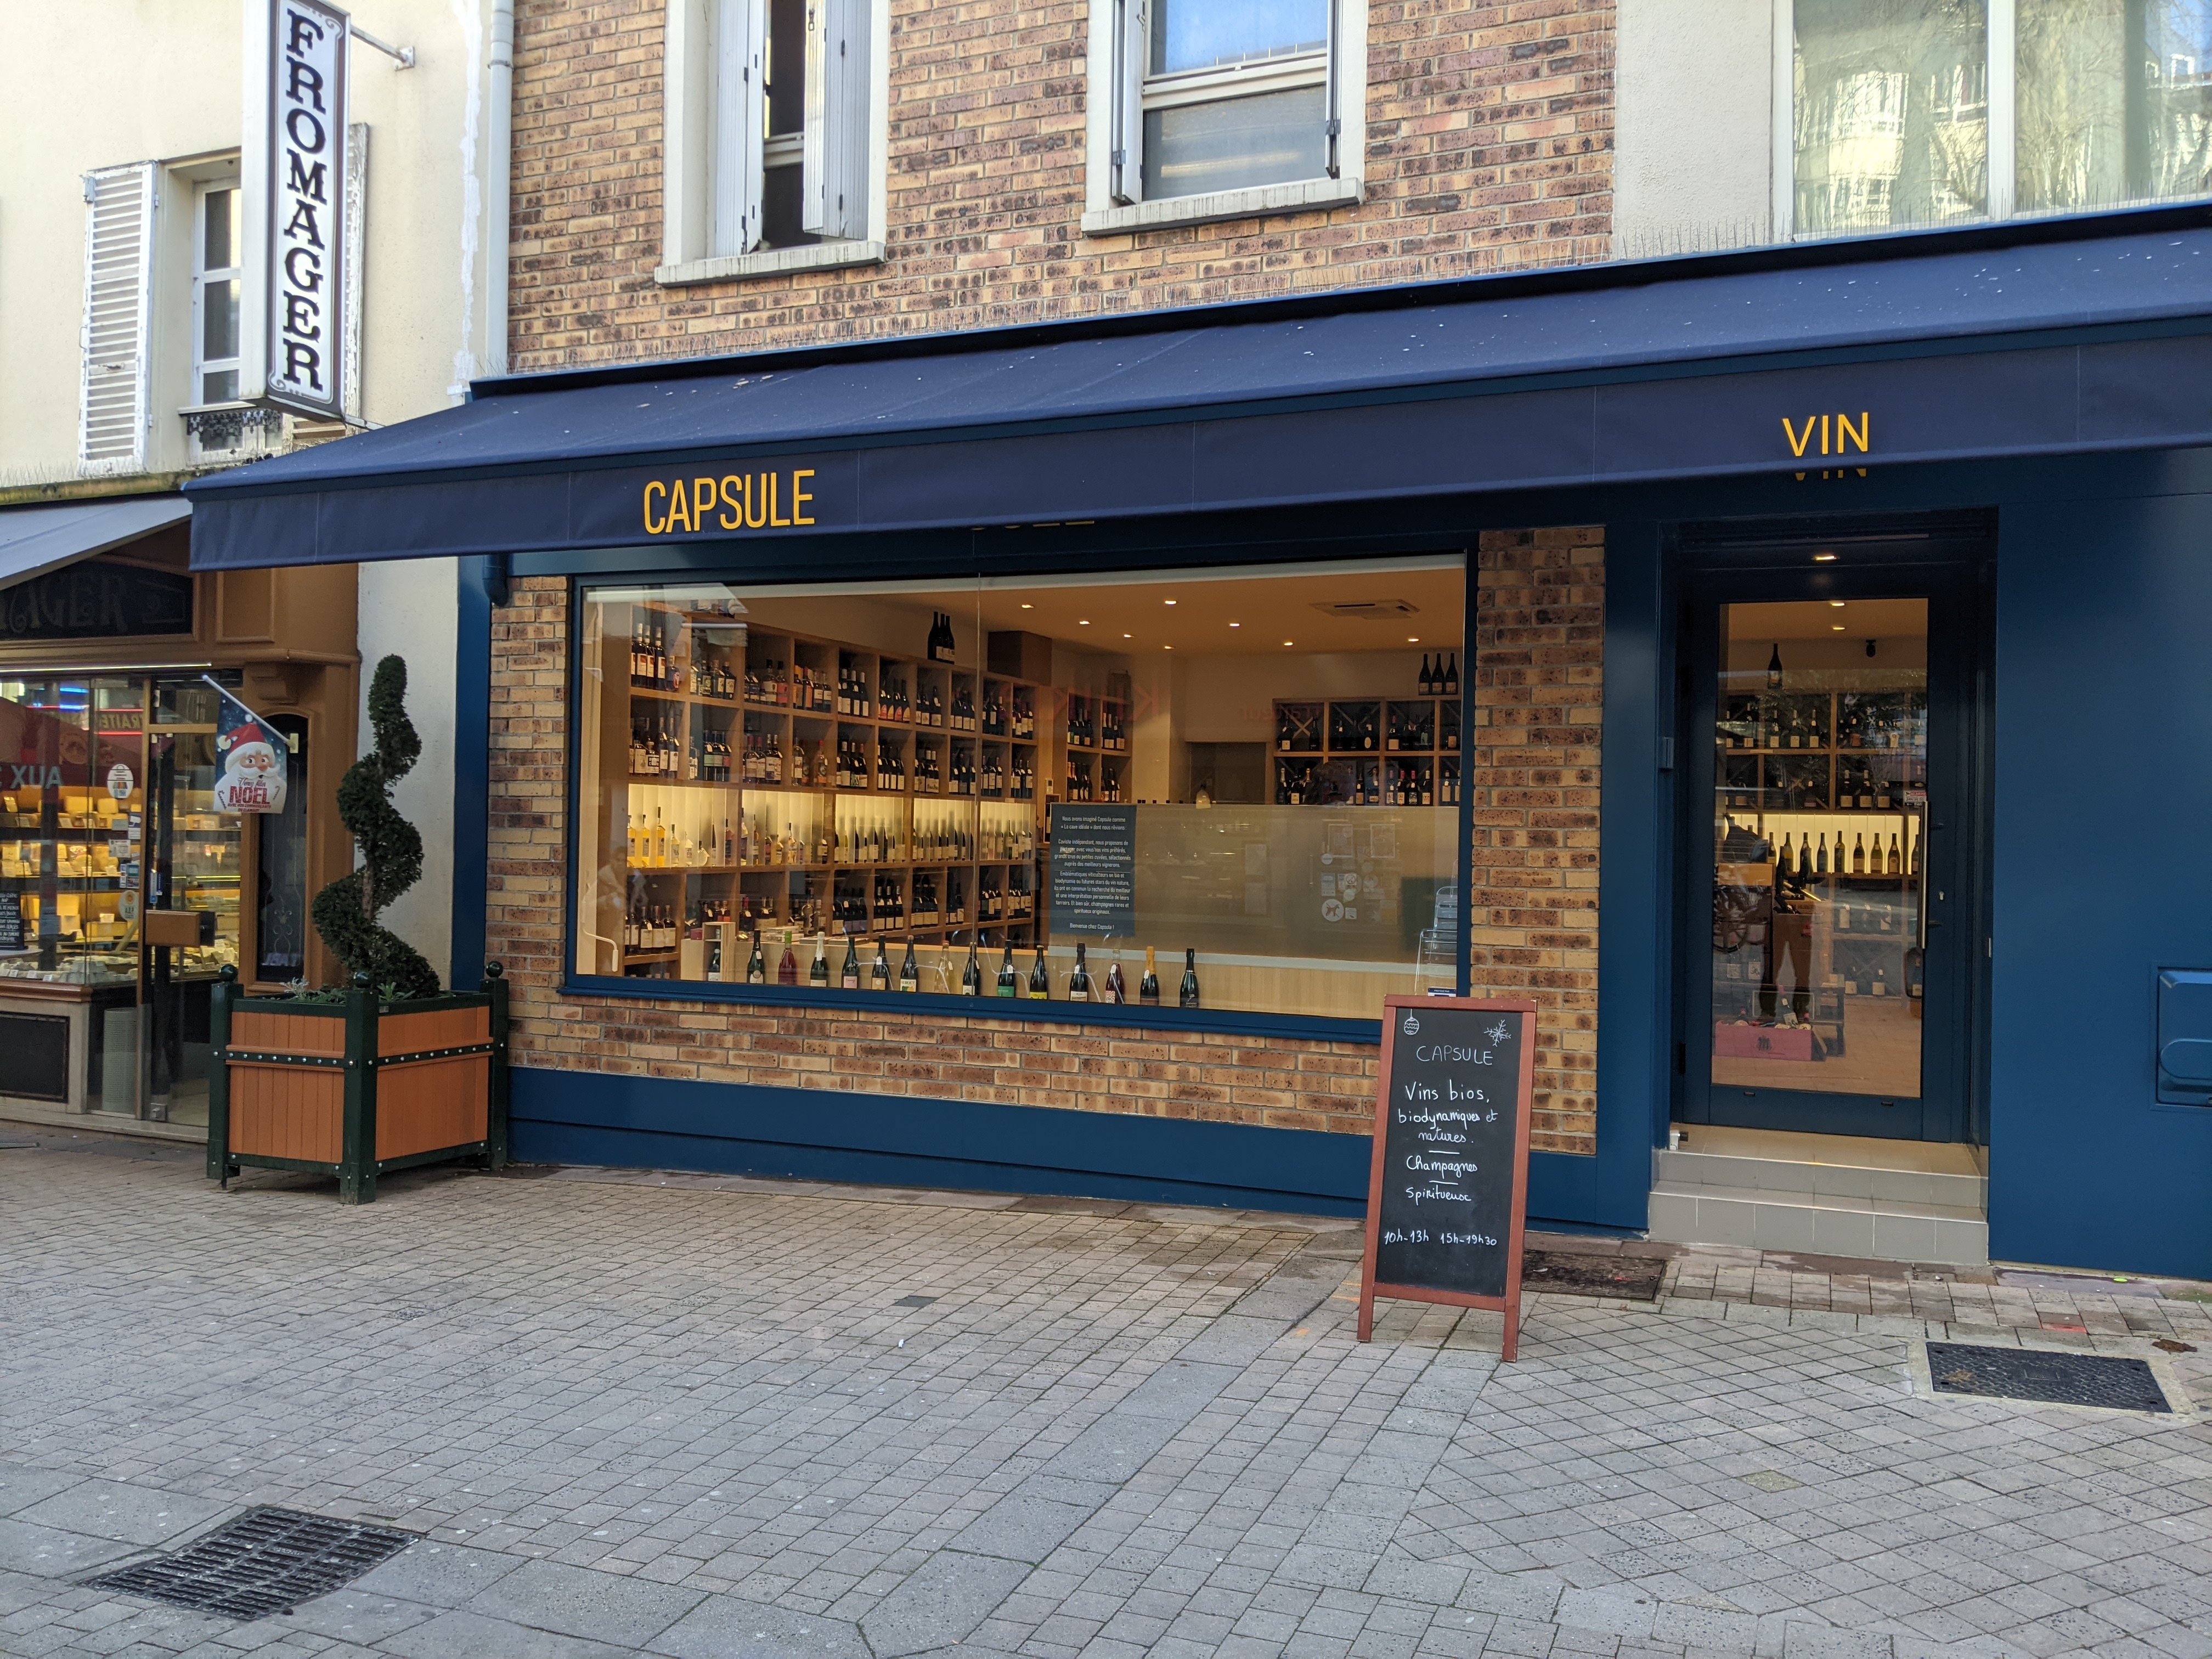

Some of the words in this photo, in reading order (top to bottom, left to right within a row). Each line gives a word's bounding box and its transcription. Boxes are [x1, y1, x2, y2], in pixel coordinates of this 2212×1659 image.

[283, 8, 328, 392] FROMAGER
[1782, 412, 1868, 456] VIN
[644, 469, 815, 534] CAPSULE
[0, 571, 128, 633] AGER
[1416, 1045, 1493, 1065] CAPSULE
[1405, 1081, 1438, 1101] Vins
[1449, 1079, 1489, 1103] bios,
[1398, 1107, 1480, 1130] biodynamiques
[1486, 1109, 1498, 1122] et
[1406, 1155, 1477, 1179] Champagnes
[1406, 1184, 1471, 1206] Spiritueux
[1384, 1228, 1429, 1245] 10h-13h
[1440, 1233, 1497, 1245] 15h-19h30
